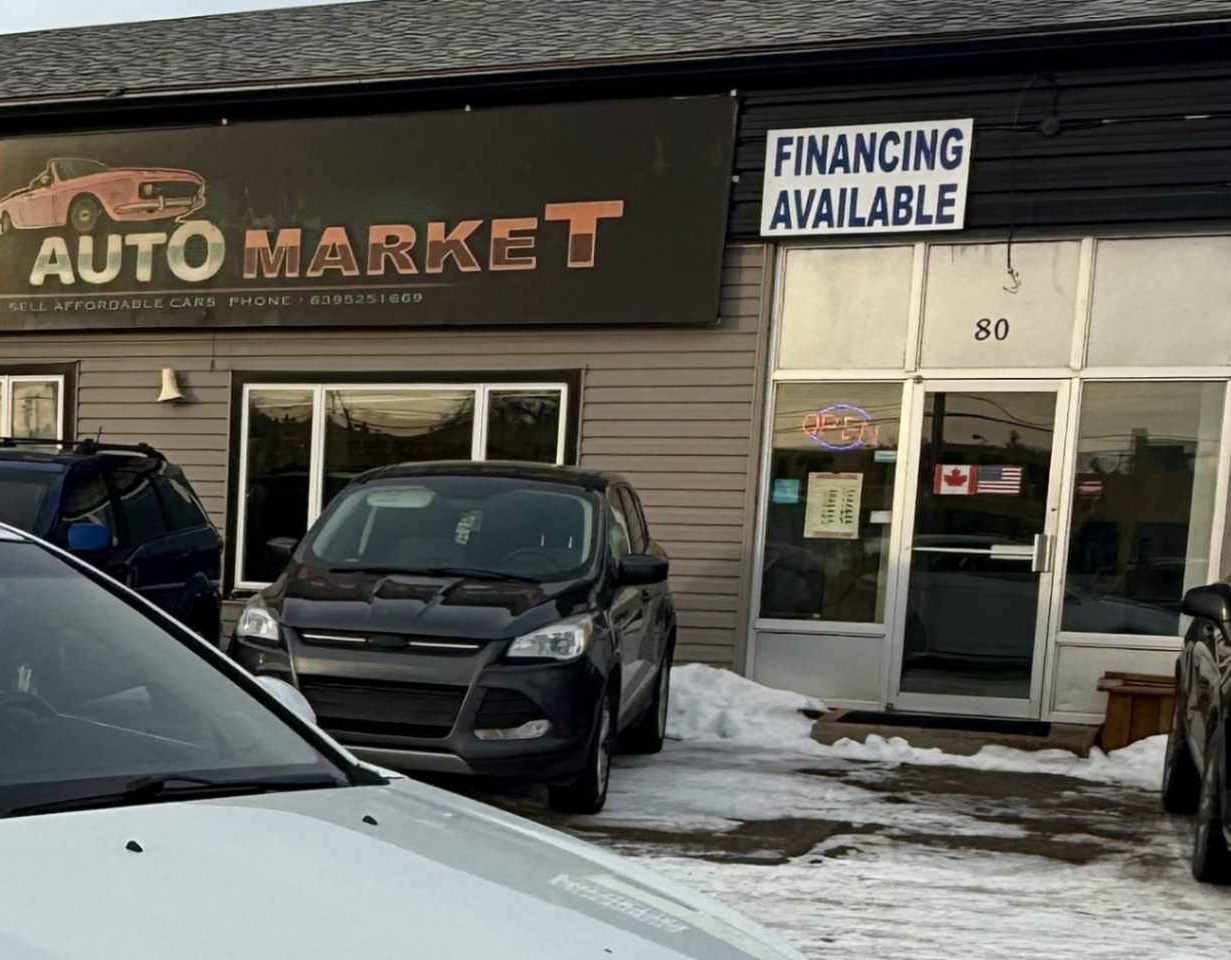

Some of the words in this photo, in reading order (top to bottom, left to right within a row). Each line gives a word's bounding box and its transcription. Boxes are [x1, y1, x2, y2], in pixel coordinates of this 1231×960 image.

[774, 128, 963, 176] FINANCING
[769, 183, 958, 230] AVAILABLE
[29, 220, 225, 285] AUTO
[244, 201, 624, 279] MARKET
[10, 302, 47, 311] SELL
[54, 299, 163, 310] AFFORDABLE
[170, 297, 216, 307] CARS
[229, 296, 290, 307] PHONE
[975, 318, 1009, 340] 80
[802, 413, 880, 446] OPEN
